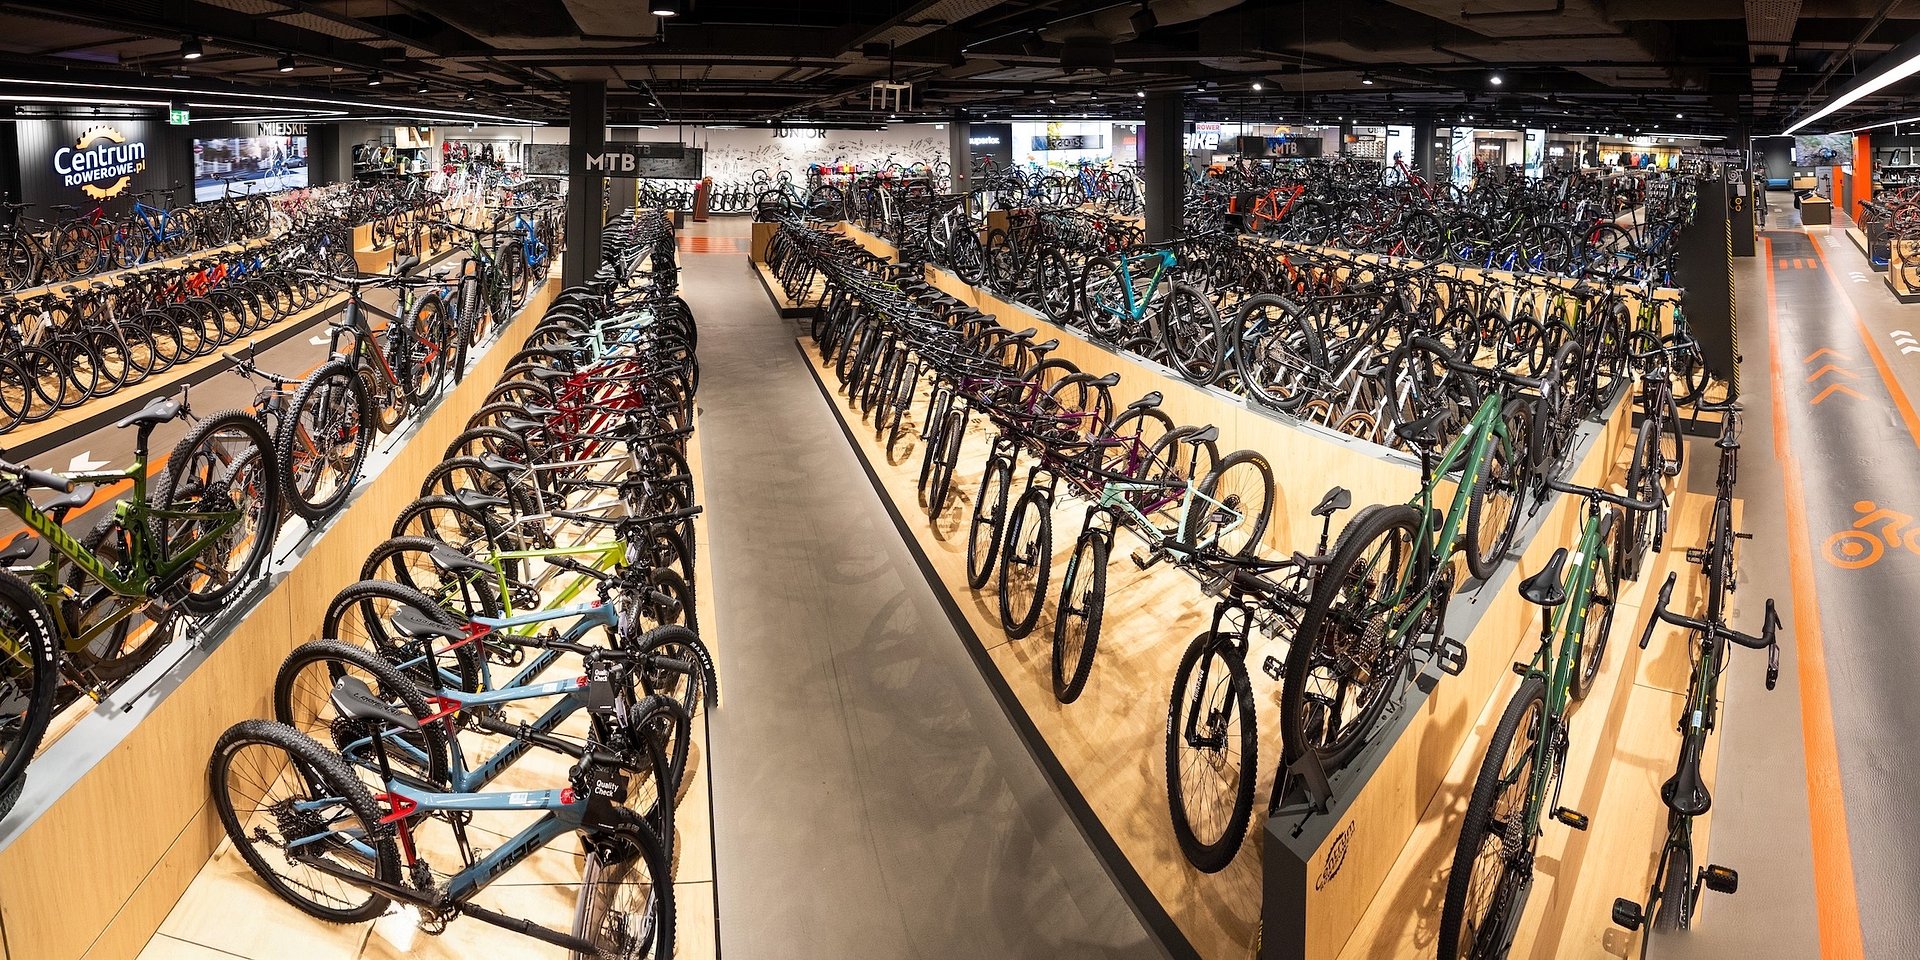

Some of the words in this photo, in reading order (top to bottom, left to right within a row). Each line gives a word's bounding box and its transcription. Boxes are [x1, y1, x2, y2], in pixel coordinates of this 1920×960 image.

[772, 127, 826, 139] JUNIOR
[1275, 142, 1298, 154] MTB
[54, 142, 145, 175] Centrum
[586, 152, 636, 172] MTB
[64, 159, 146, 187] ROWEROWE.pl
[28, 608, 53, 662] MAXXIS
[689, 641, 711, 671] MAXXIS
[594, 787, 614, 798] Check
[596, 779, 620, 793] Quality
